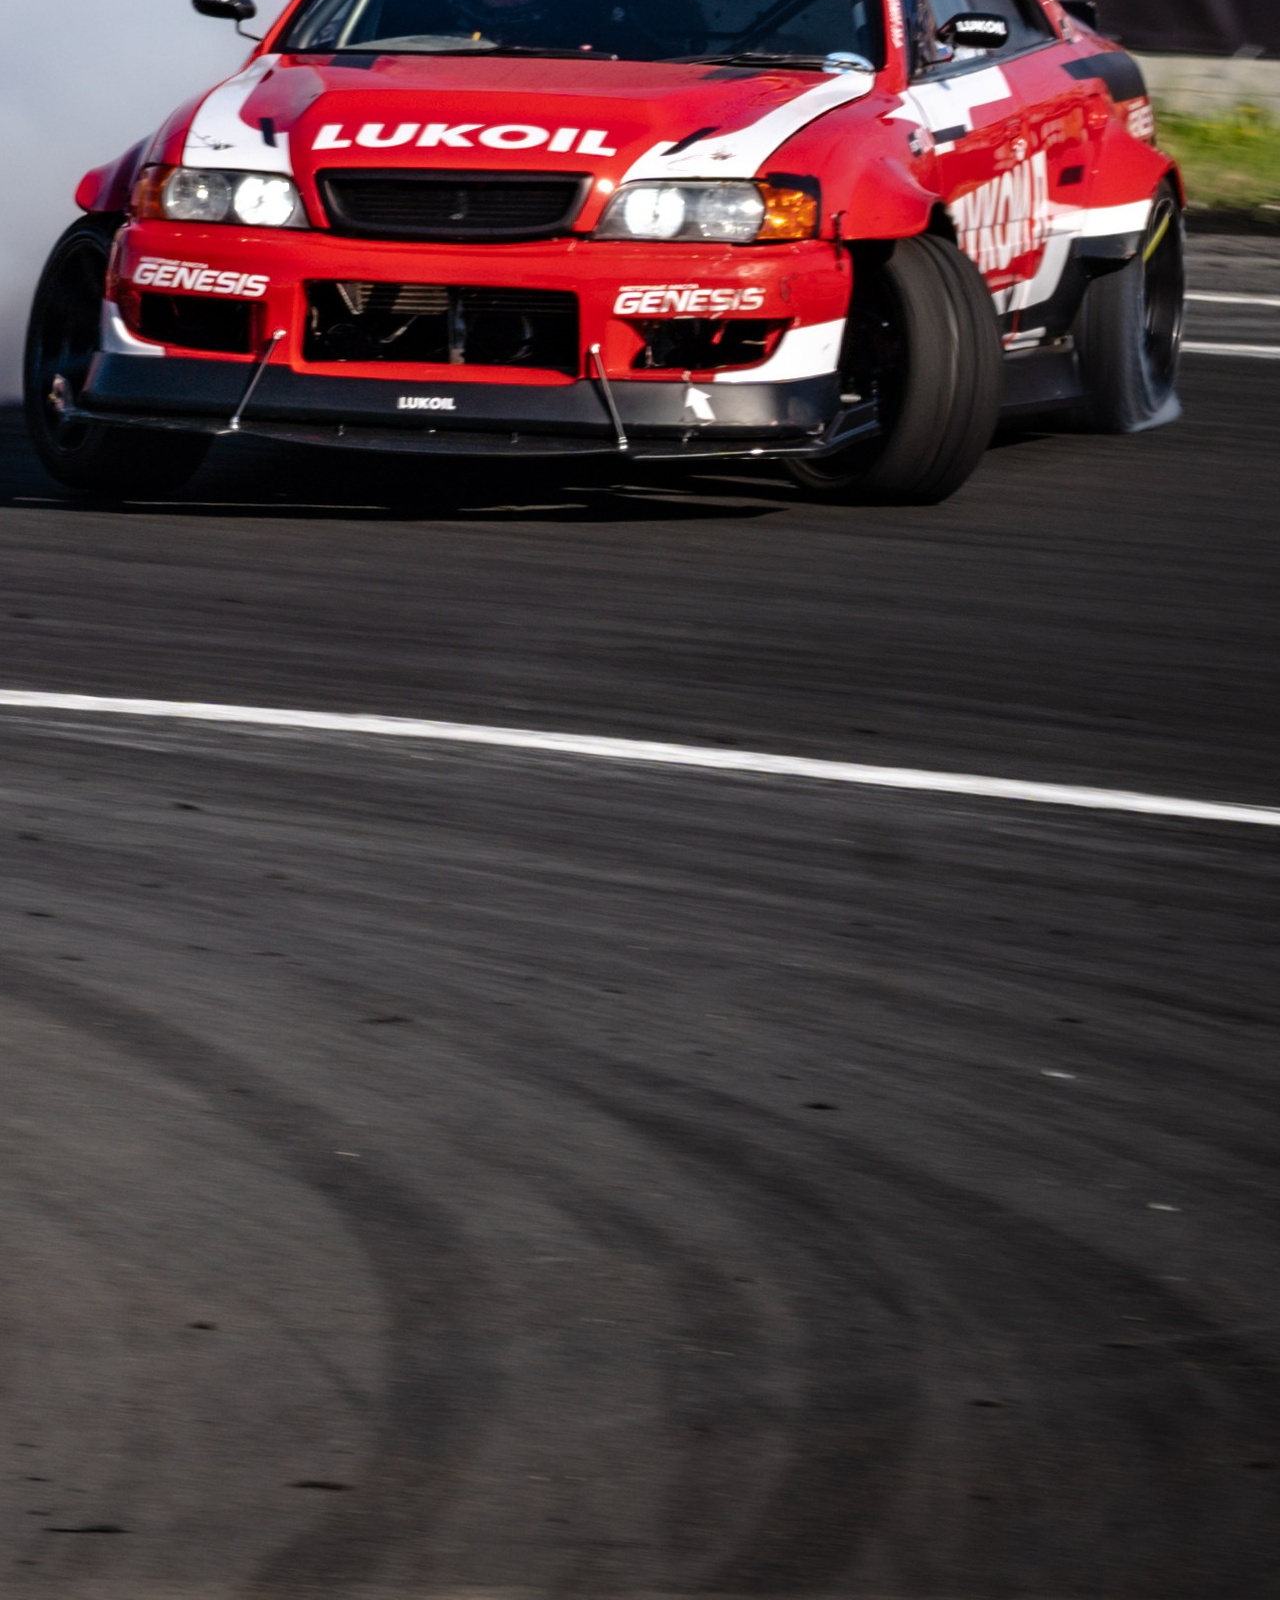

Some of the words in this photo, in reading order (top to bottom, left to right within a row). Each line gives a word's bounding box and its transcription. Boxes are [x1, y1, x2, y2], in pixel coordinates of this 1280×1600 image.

[311, 122, 618, 157] LUKOIL
[132, 263, 271, 297] GENESIS
[613, 288, 767, 315] GENESIS
[397, 396, 457, 410] LUKOIL
